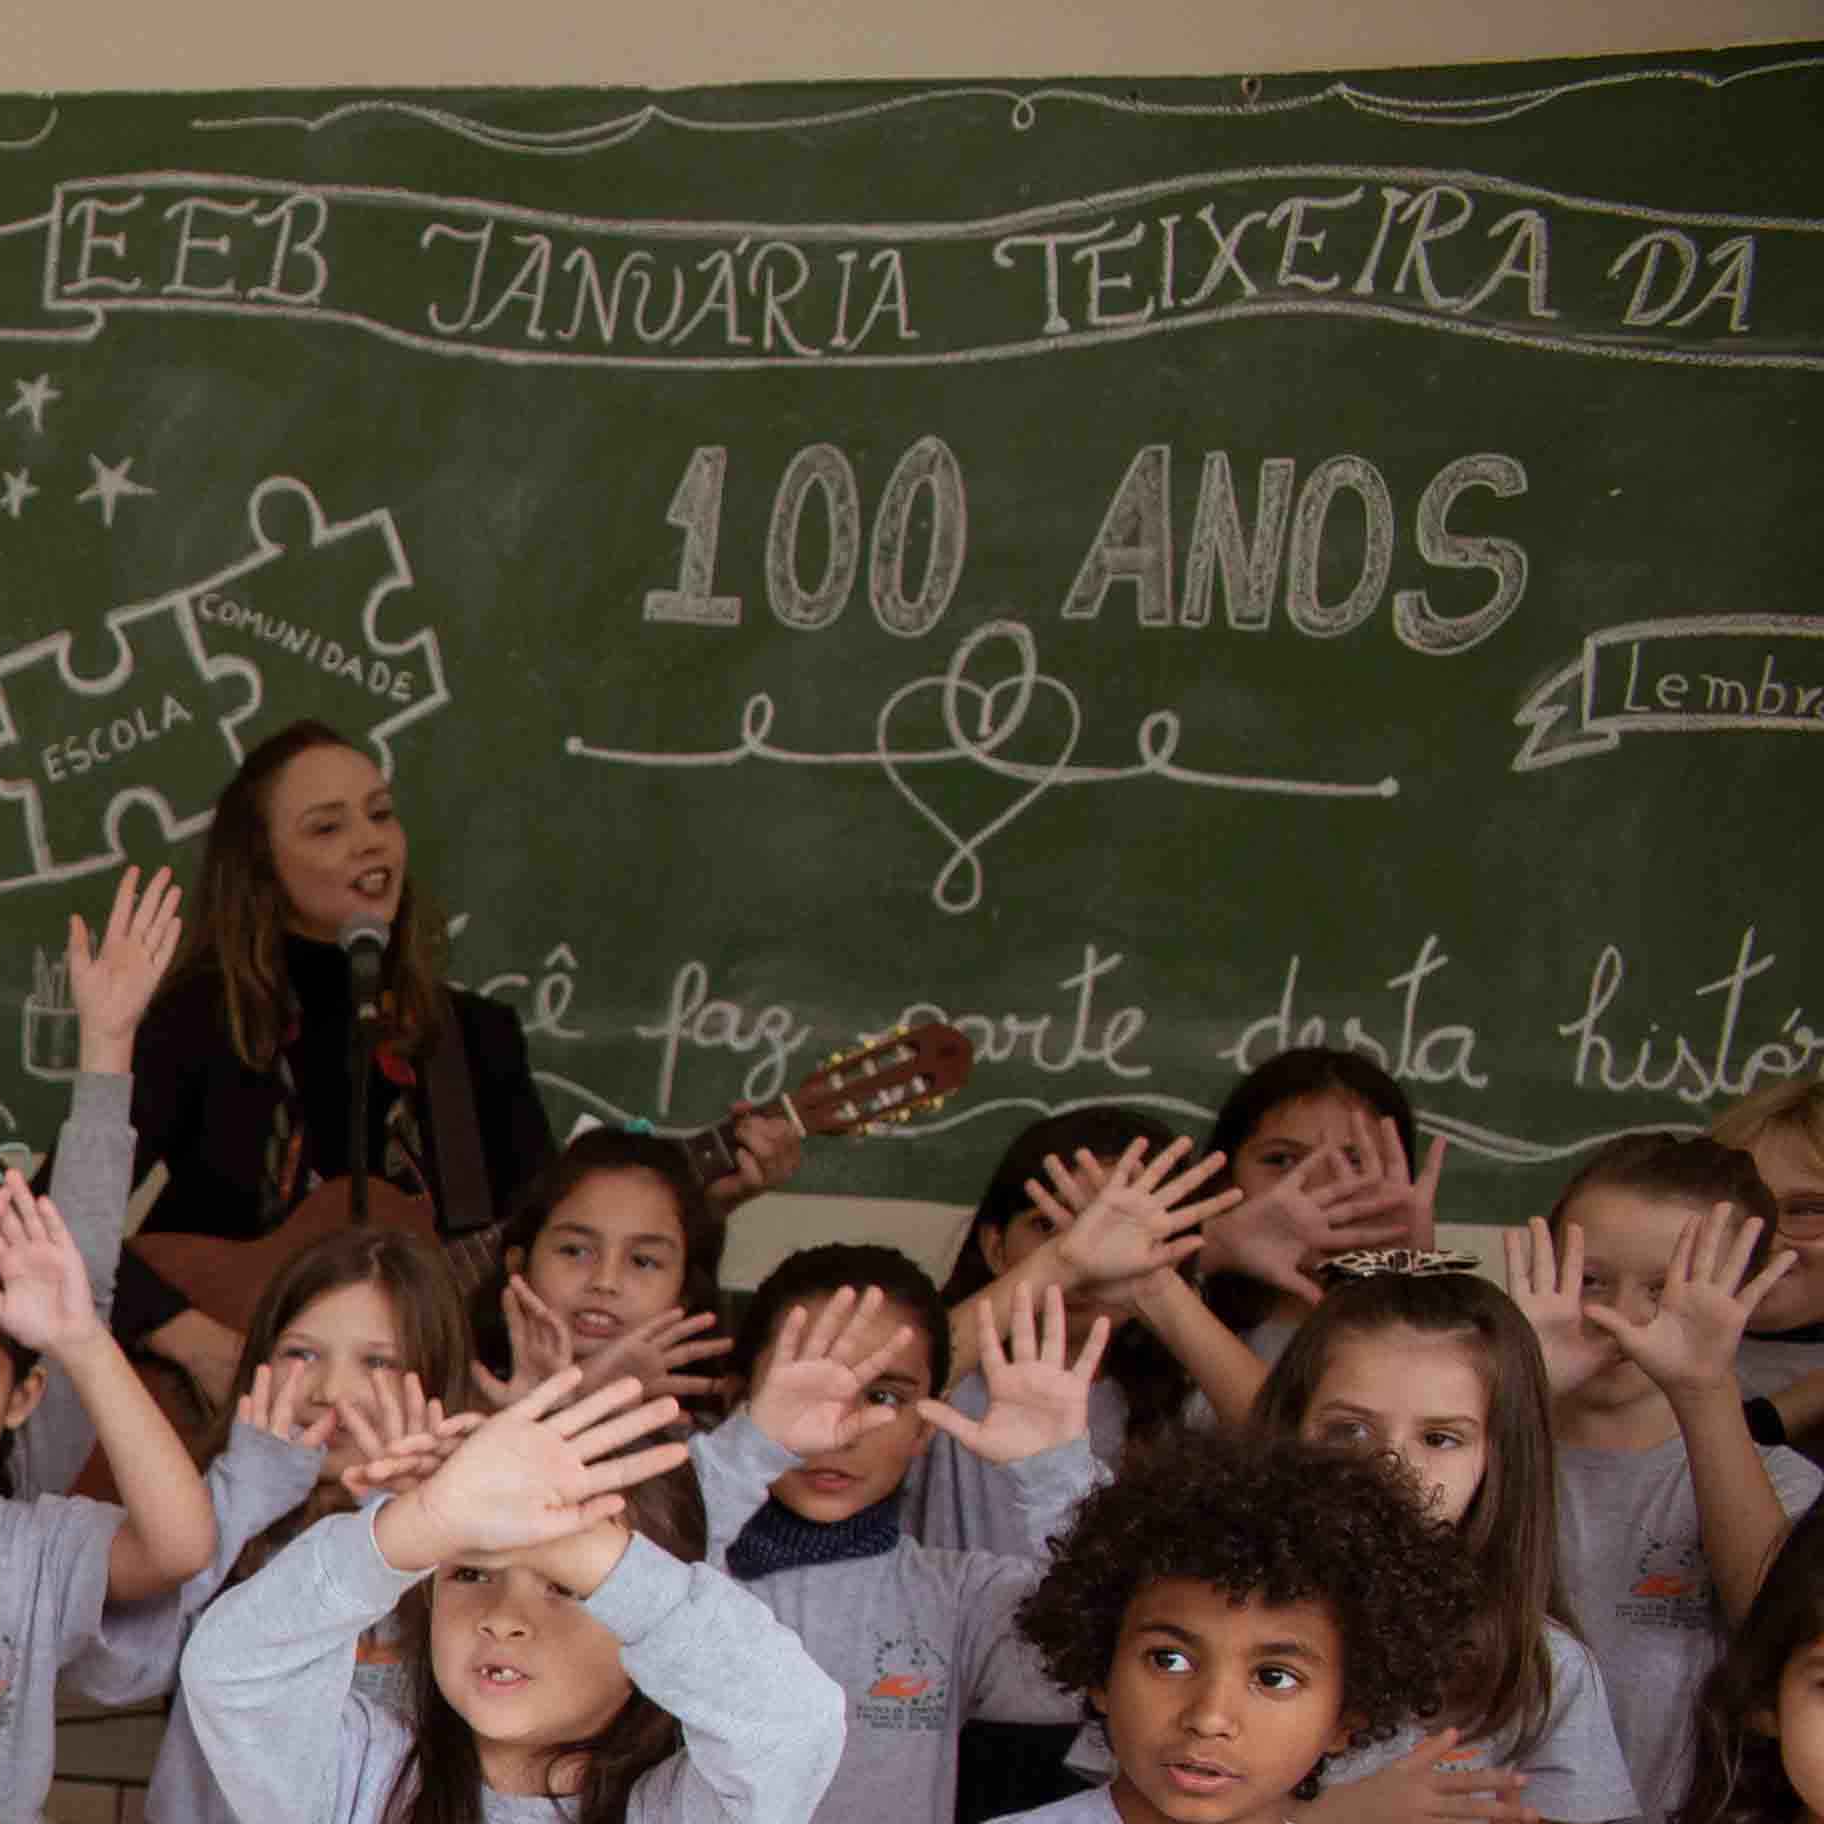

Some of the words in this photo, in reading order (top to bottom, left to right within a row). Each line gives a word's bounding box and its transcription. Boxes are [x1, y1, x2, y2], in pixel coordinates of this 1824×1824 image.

[63, 193, 328, 308] EEB
[420, 219, 920, 356] JANUÁRIA
[993, 184, 1558, 336] TEIXEIRA
[1608, 229, 1755, 332] DA
[641, 434, 967, 637] 100
[1061, 443, 1528, 655] ANOS
[198, 592, 416, 702] COMUNIDADE
[1624, 641, 1824, 716] Lembr
[42, 694, 192, 784] ESCOLA
[635, 960, 809, 1118] faz
